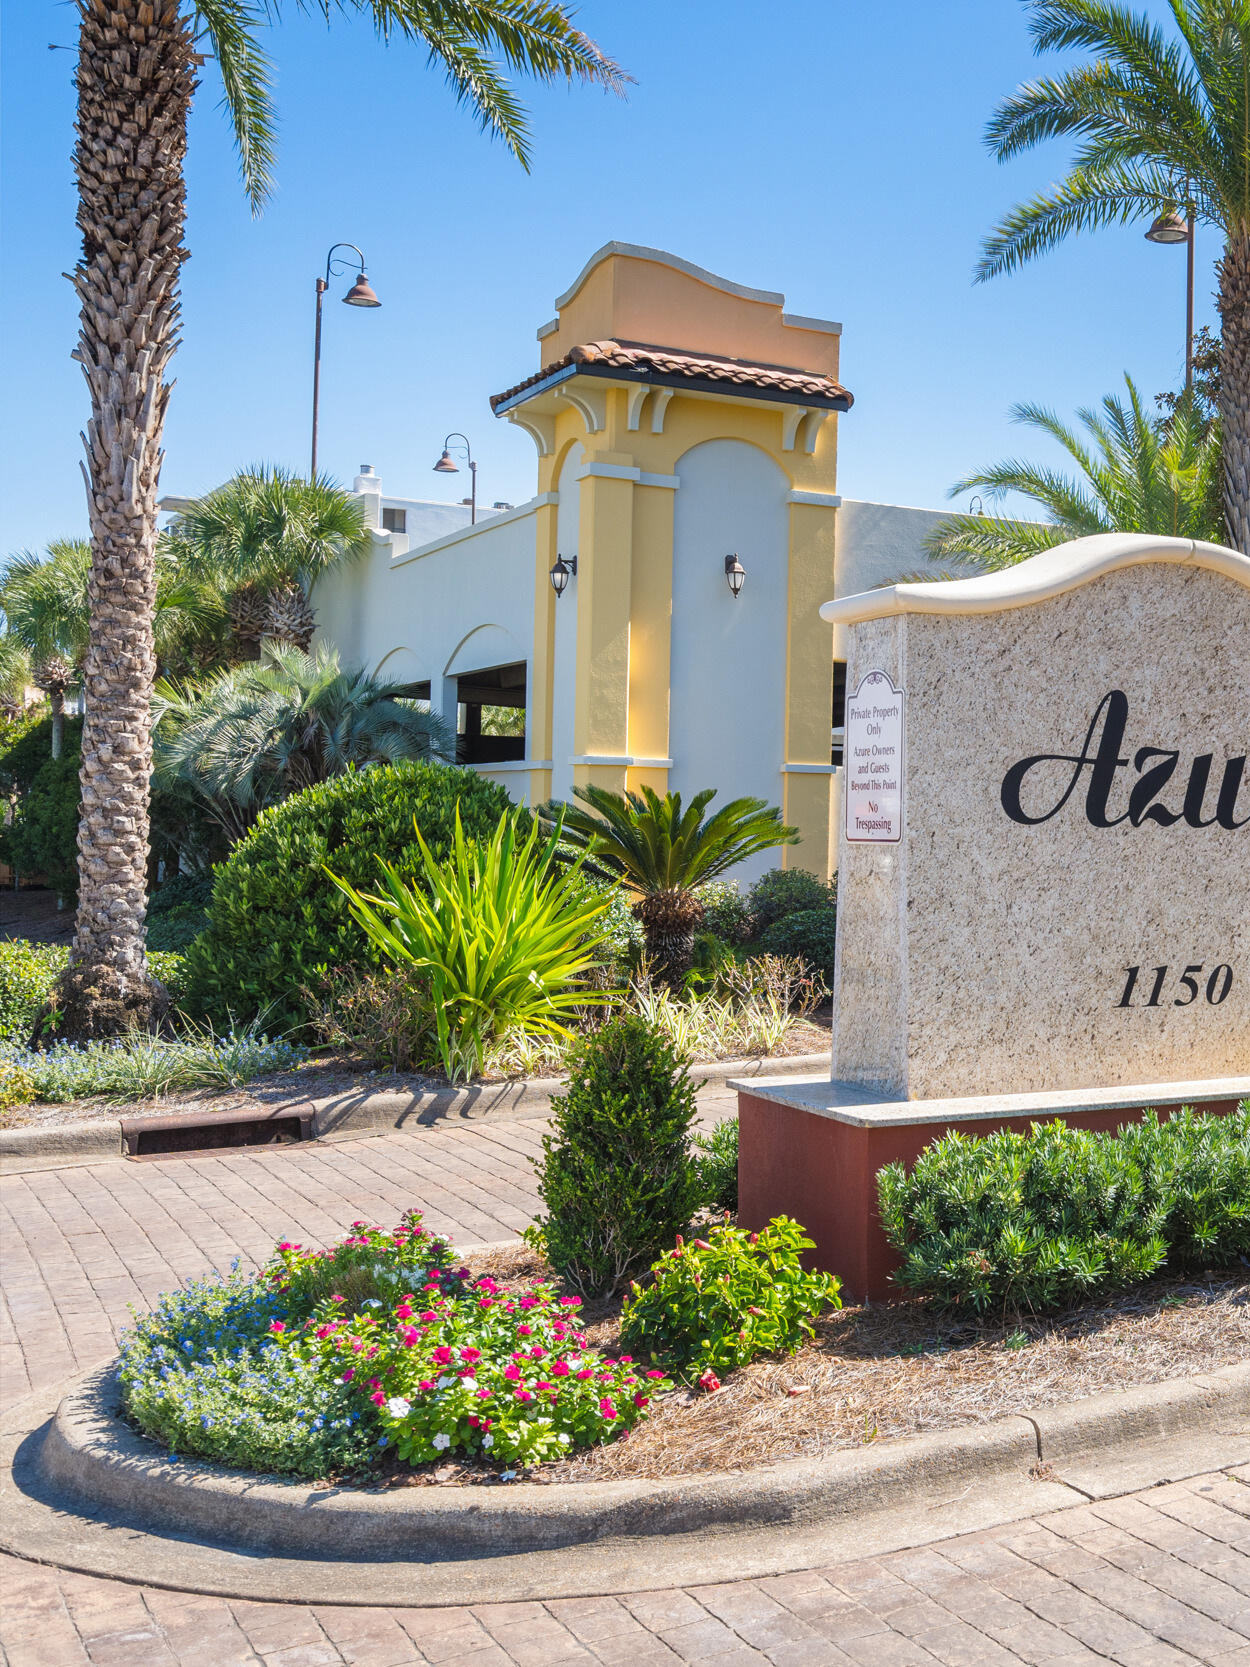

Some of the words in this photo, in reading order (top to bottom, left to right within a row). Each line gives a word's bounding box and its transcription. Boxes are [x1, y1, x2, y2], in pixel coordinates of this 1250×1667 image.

[851, 706, 871, 719] Private
[873, 705, 899, 721] Property
[867, 722, 881, 738] Only
[854, 745, 870, 757] Azure
[872, 744, 895, 756] Owners
[858, 763, 869, 774] and
[870, 762, 890, 774] Guests
[851, 780, 870, 794] Beyond
[871, 780, 881, 791] This
[882, 779, 896, 790] Point
[868, 801, 878, 813] No
[856, 817, 892, 833] Trespassing
[1113, 964, 1233, 1008] 1150
